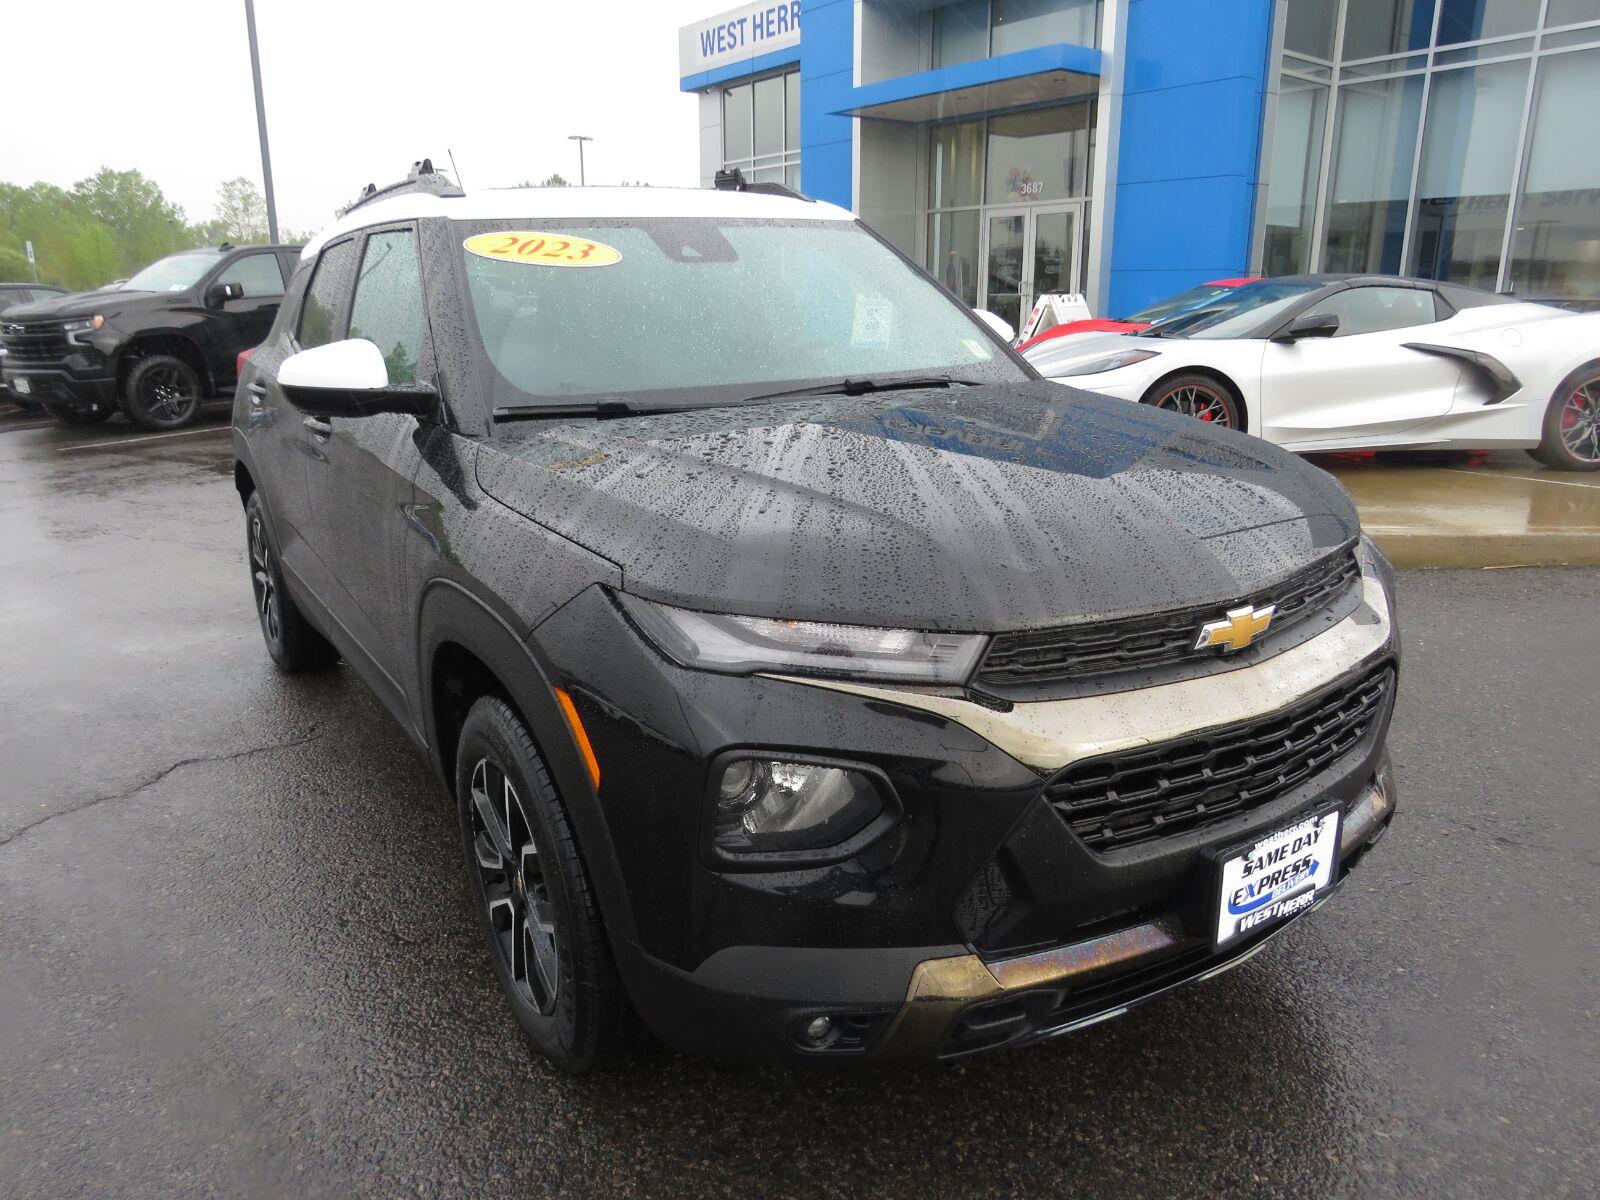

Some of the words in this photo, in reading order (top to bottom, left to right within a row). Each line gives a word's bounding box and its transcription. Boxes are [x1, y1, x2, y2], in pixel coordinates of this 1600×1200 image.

[700, 17, 747, 58] WEST
[752, 0, 801, 42] HERR
[1021, 181, 1044, 195] 3687
[489, 237, 596, 260] 2023
[1241, 844, 1288, 879] SAME
[1291, 826, 1324, 856] DAY
[1232, 854, 1313, 906] EXPRESS
[1272, 869, 1311, 898] DELIVERY
